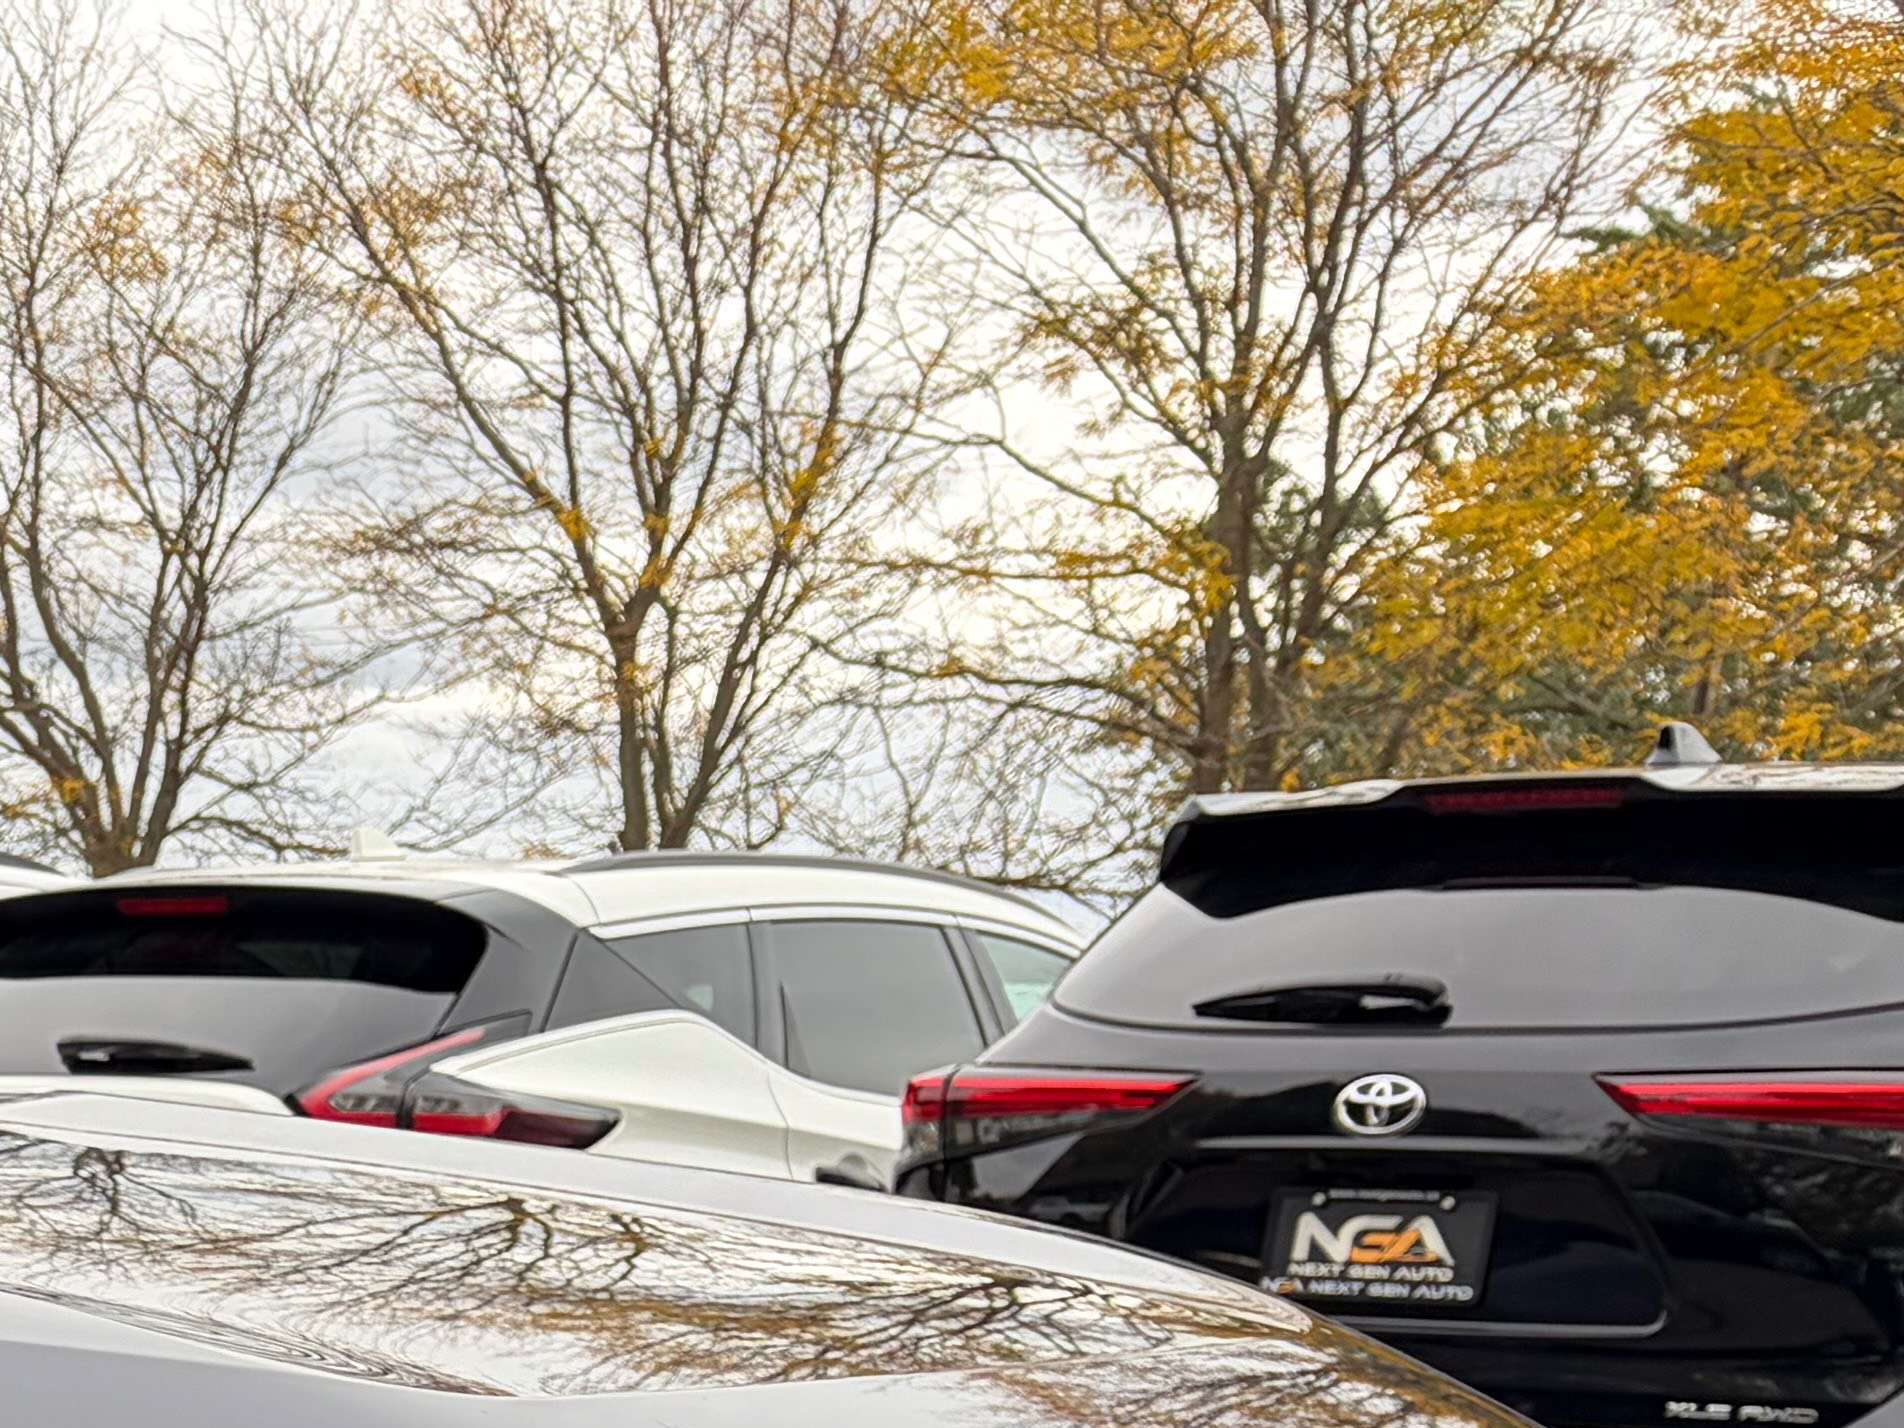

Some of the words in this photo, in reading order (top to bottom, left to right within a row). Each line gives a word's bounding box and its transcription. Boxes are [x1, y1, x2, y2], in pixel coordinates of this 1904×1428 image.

[1288, 1262, 1346, 1277] NEXT
[1347, 1264, 1391, 1280] GEN
[1393, 1266, 1455, 1282] AUTO
[1308, 1280, 1366, 1295] NEXT
[1366, 1282, 1410, 1298] GEN
[1411, 1284, 1474, 1301] AUTO
